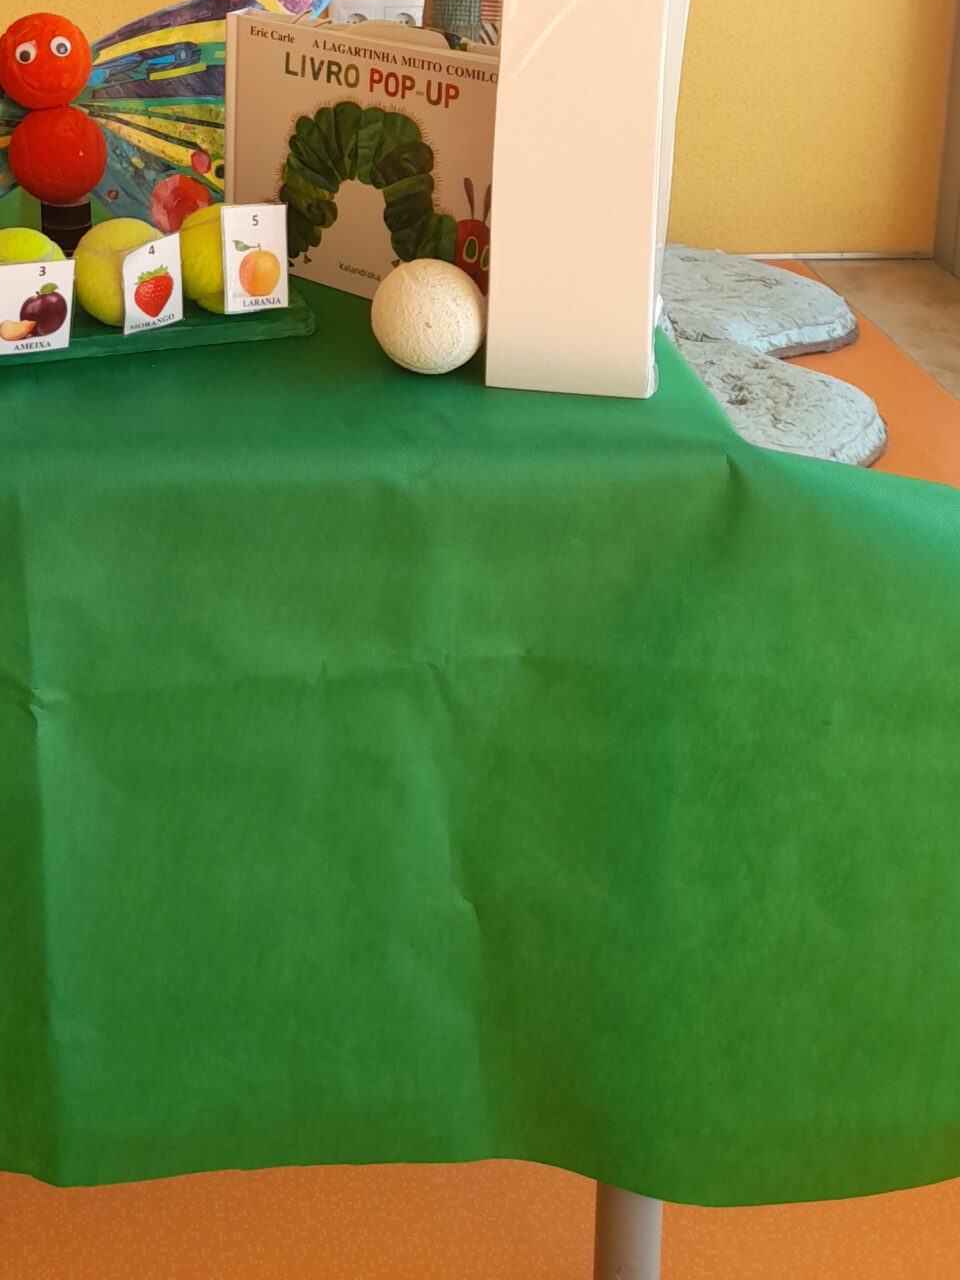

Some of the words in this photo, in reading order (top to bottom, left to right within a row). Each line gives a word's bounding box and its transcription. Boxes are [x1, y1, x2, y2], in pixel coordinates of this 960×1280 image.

[250, 26, 268, 38] Eric
[270, 30, 295, 44] Carle
[312, 40, 320, 49] A
[323, 40, 398, 65] LAGARTINHA
[401, 56, 442, 72] MUITO
[285, 52, 360, 88] LIVRO
[369, 68, 460, 109] POP-UP
[252, 214, 259, 226] 5
[148, 245, 155, 256] 4
[39, 266, 46, 276] 3
[339, 261, 381, 282] kalandraka
[243, 296, 281, 308] LARANJA
[130, 313, 175, 330] MORANGO
[12, 340, 51, 351] AMEIXA
